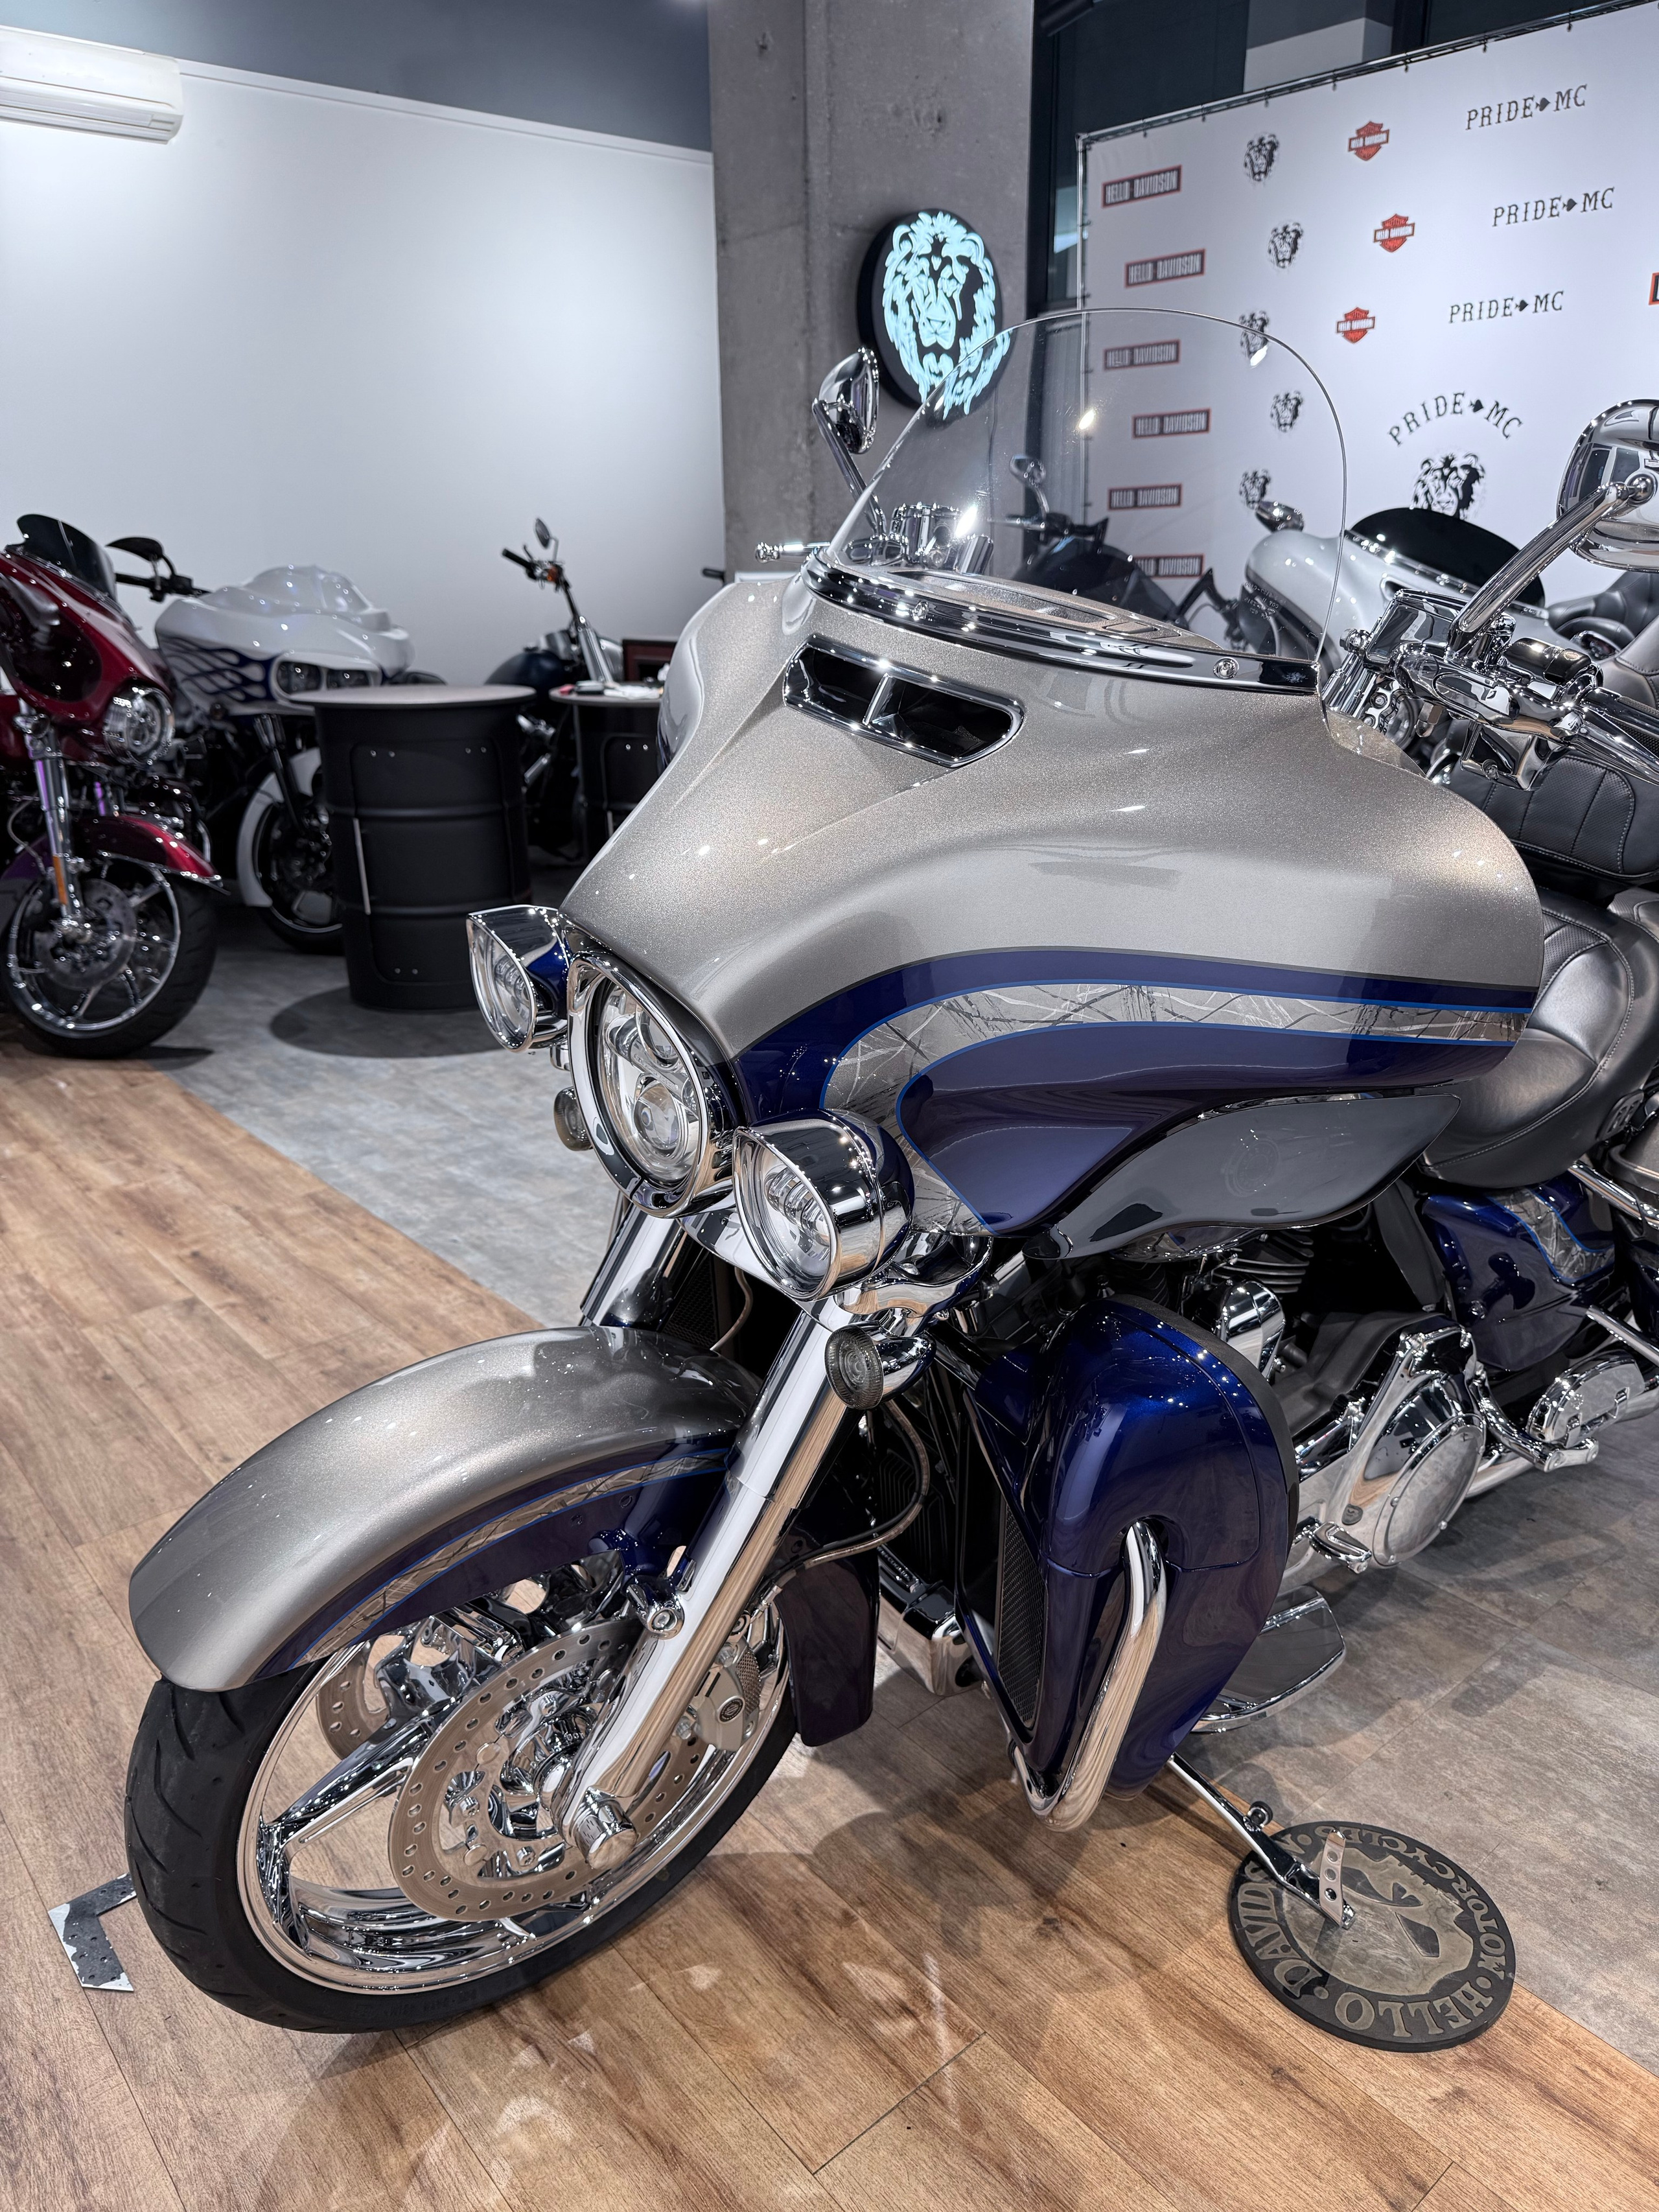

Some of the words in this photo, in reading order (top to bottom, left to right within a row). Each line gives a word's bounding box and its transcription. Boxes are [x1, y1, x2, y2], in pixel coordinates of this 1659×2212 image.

[1465, 95, 1535, 130] PRIDE
[1553, 84, 1588, 112] MC
[1105, 180, 1131, 205] HELLO
[1133, 169, 1179, 198] DAVIDSON
[1492, 195, 1562, 227] PRIDE
[1580, 186, 1615, 213] MC
[1128, 262, 1154, 286] HELLO
[1156, 253, 1202, 281] DAVIDSON
[1448, 296, 1515, 323] PRIDE
[1532, 290, 1565, 314] MC
[1387, 391, 1465, 447] PRIDE
[1483, 400, 1524, 440] MC
[1335, 1981, 1494, 2037] HELLO
